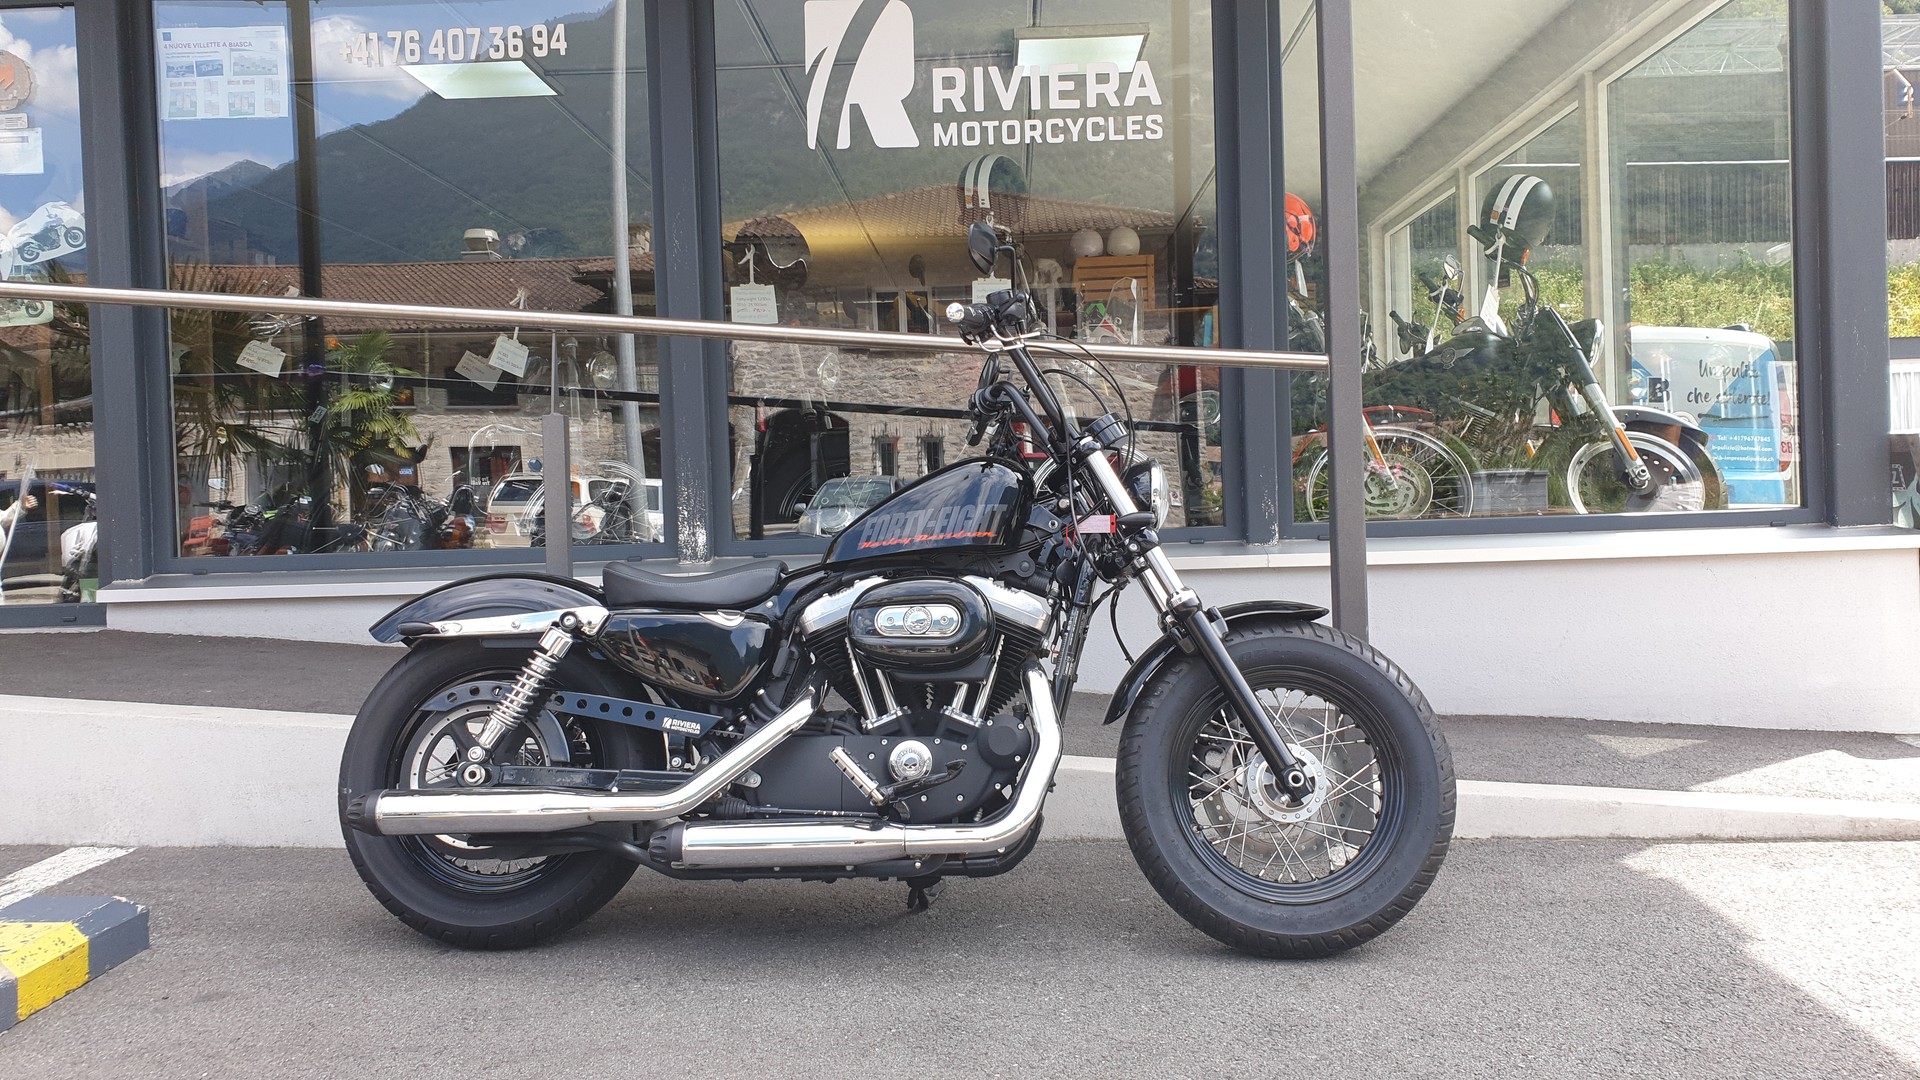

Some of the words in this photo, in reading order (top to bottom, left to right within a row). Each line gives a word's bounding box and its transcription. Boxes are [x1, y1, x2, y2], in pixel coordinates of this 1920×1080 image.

[192, 41, 221, 49] VILLETTE
[339, 32, 380, 64] +41
[387, 30, 421, 63] 76
[428, 28, 481, 61] 407
[488, 25, 524, 60] 36
[532, 23, 568, 58] 94
[932, 60, 1162, 113] RIVIERA
[933, 114, 1164, 147] MOTORCYCLES
[1687, 387, 1712, 404] che
[857, 503, 1009, 550] FORTY-EIGHT
[672, 719, 701, 730] RIVIERA
